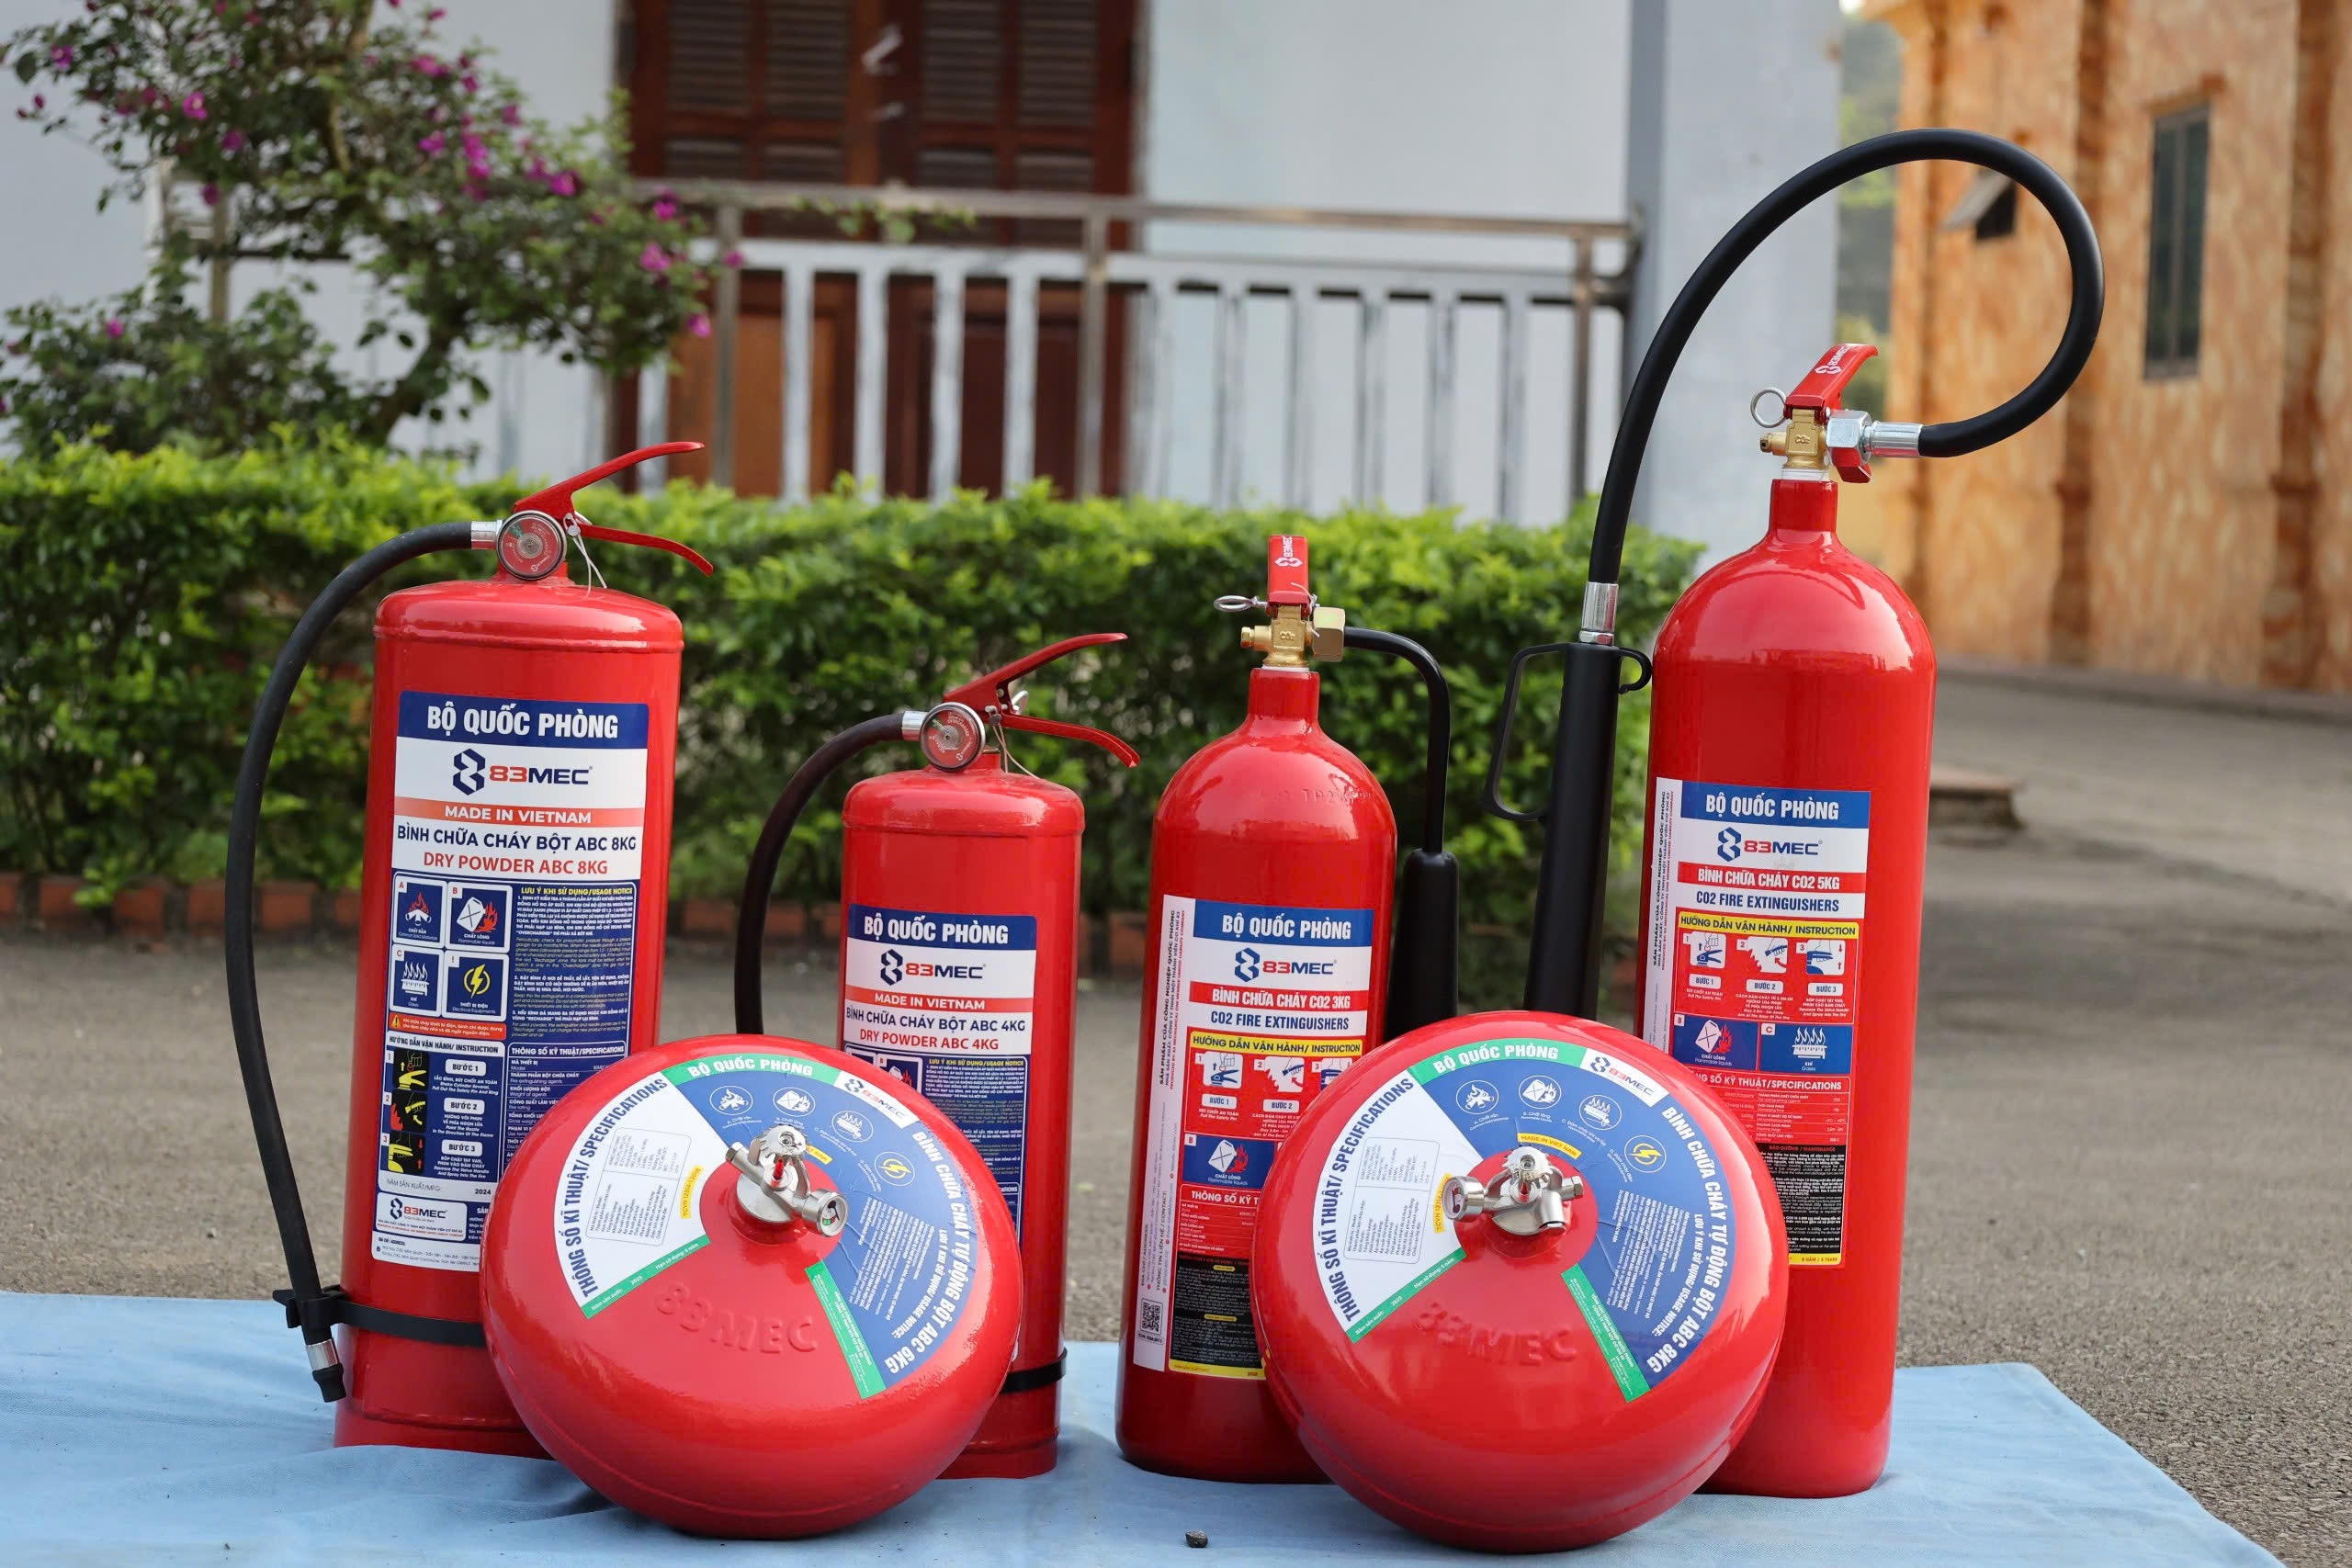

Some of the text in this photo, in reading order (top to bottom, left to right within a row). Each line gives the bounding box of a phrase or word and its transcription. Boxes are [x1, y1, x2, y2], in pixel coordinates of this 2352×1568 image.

[427, 701, 618, 739] BỘ QUỐC PHÒNG
[445, 806, 592, 823] MADE IN VIETNAM
[1706, 792, 1839, 820] BỘ QUỐC PHÒNG
[397, 823, 636, 853] BÌNH CHỮA CHÁY BỘT ABC 8KG
[424, 852, 607, 874] DRY POWDER ABC 8KG
[1698, 868, 1723, 883] BÌNH
[1725, 870, 1755, 886] CHỮA
[1758, 873, 1789, 887] CHÁY
[1817, 877, 1839, 890] 5KG
[1719, 894, 1743, 907] FIRE
[1747, 896, 1839, 911] EXTINGUISHERS
[865, 913, 1008, 943] BỘ QUỐC PHÒNG
[1222, 913, 1351, 939] BỘ QUỐC PHÒNG
[1680, 916, 1855, 935] HƯỚNG DẪN VẬN HÀNH/ INSTRUCTION
[875, 993, 985, 1010] MADE IN VIETNAM
[1212, 988, 1238, 1003] BÌNH
[1242, 990, 1273, 1006] CHỮA
[1277, 994, 1307, 1008] CHÁY
[1332, 996, 1351, 1009] 3KG
[846, 1007, 1025, 1033] BÌNH CHỮA CHÁY BỘT ABC 4KG
[1236, 1013, 1261, 1026] FIRE
[1265, 1016, 1349, 1030] EXTINGUISHERS
[390, 1036, 408, 1045] HƯỚNG
[410, 1037, 420, 1045] DẪN
[422, 1039, 433, 1048] VẬN
[456, 1044, 498, 1053] INSTRUCTION
[860, 1029, 999, 1049] DRY POWDER ABC 4KG
[1193, 1035, 1360, 1053] HƯỚNG DẪN VẬN HÀNH/ INSTRUCTION
[538, 1046, 548, 1055] SỐ
[549, 1046, 558, 1055] KỸ
[560, 1046, 624, 1056] THUẬT/SPECIFICATIONS
[1433, 1042, 1558, 1073] BỘ QUỐC PHÒNG
[687, 1055, 814, 1077] BỘ QUỐC PHÒNG
[1710, 1073, 1841, 1089] SỐ KỸ THUẬT/SPECIFICATIONS
[450, 1101, 470, 1110] BƯỚC
[448, 1143, 469, 1152] BƯỚC
[1549, 1139, 1562, 1148] VIET
[1562, 1145, 1577, 1156] NAM
[559, 1079, 667, 1297] THÔNG SỐ KĨ THUẬT/ SPECIFICATIONS
[1317, 1078, 1414, 1321] THÔNG SỐ KĨ THUẬT/ SPECIFICATIONS
[1646, 1107, 1728, 1372] BÌNH CHỮA CHÁY TỰ ĐỘNG BỘT ABC 8KG
[885, 1132, 972, 1373] BÌNH CHỮA CHÁY TỰ ĐỘNG BỘT ABC 6KG
